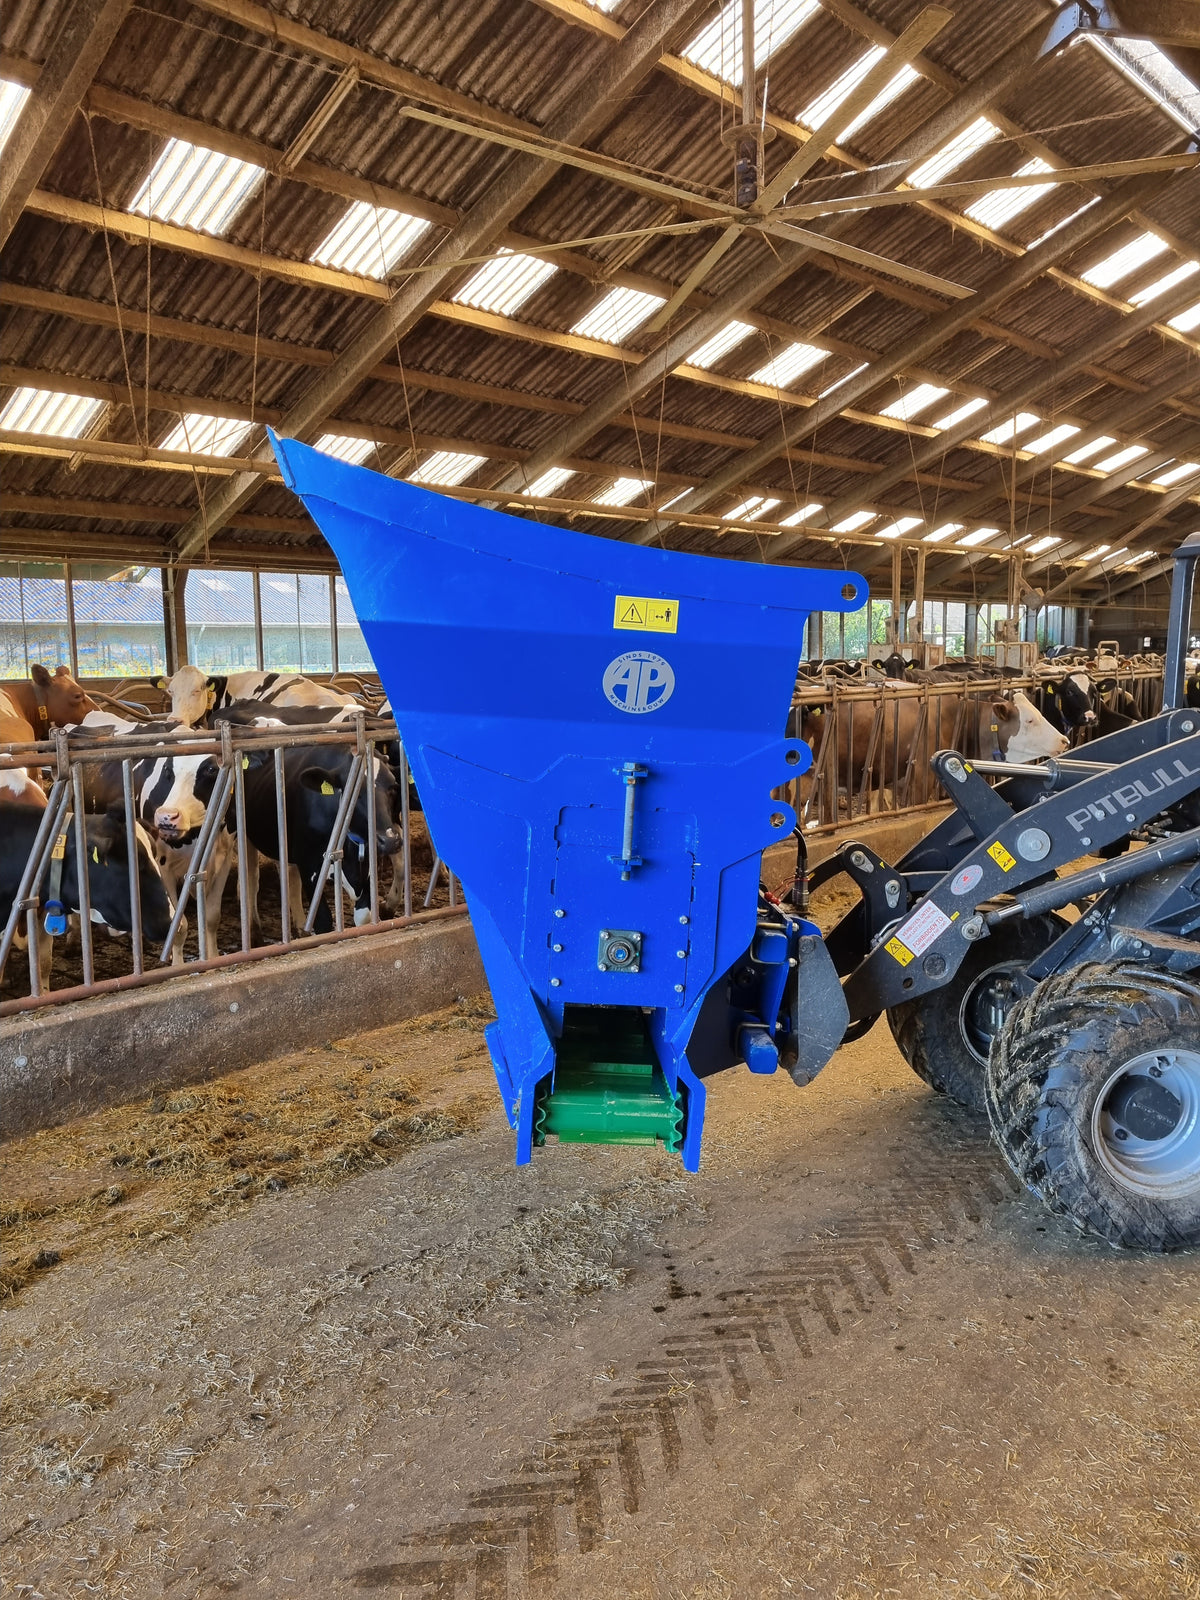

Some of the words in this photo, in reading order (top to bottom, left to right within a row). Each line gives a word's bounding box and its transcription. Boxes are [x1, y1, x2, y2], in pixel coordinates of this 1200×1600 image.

[618, 653, 642, 664] SINDS
[610, 659, 669, 707] AP
[609, 694, 665, 712] MACHINEBOUW
[1065, 759, 1200, 833] PITBULL
[912, 921, 938, 948] FORBIDDEN
[936, 915, 944, 925] TO
